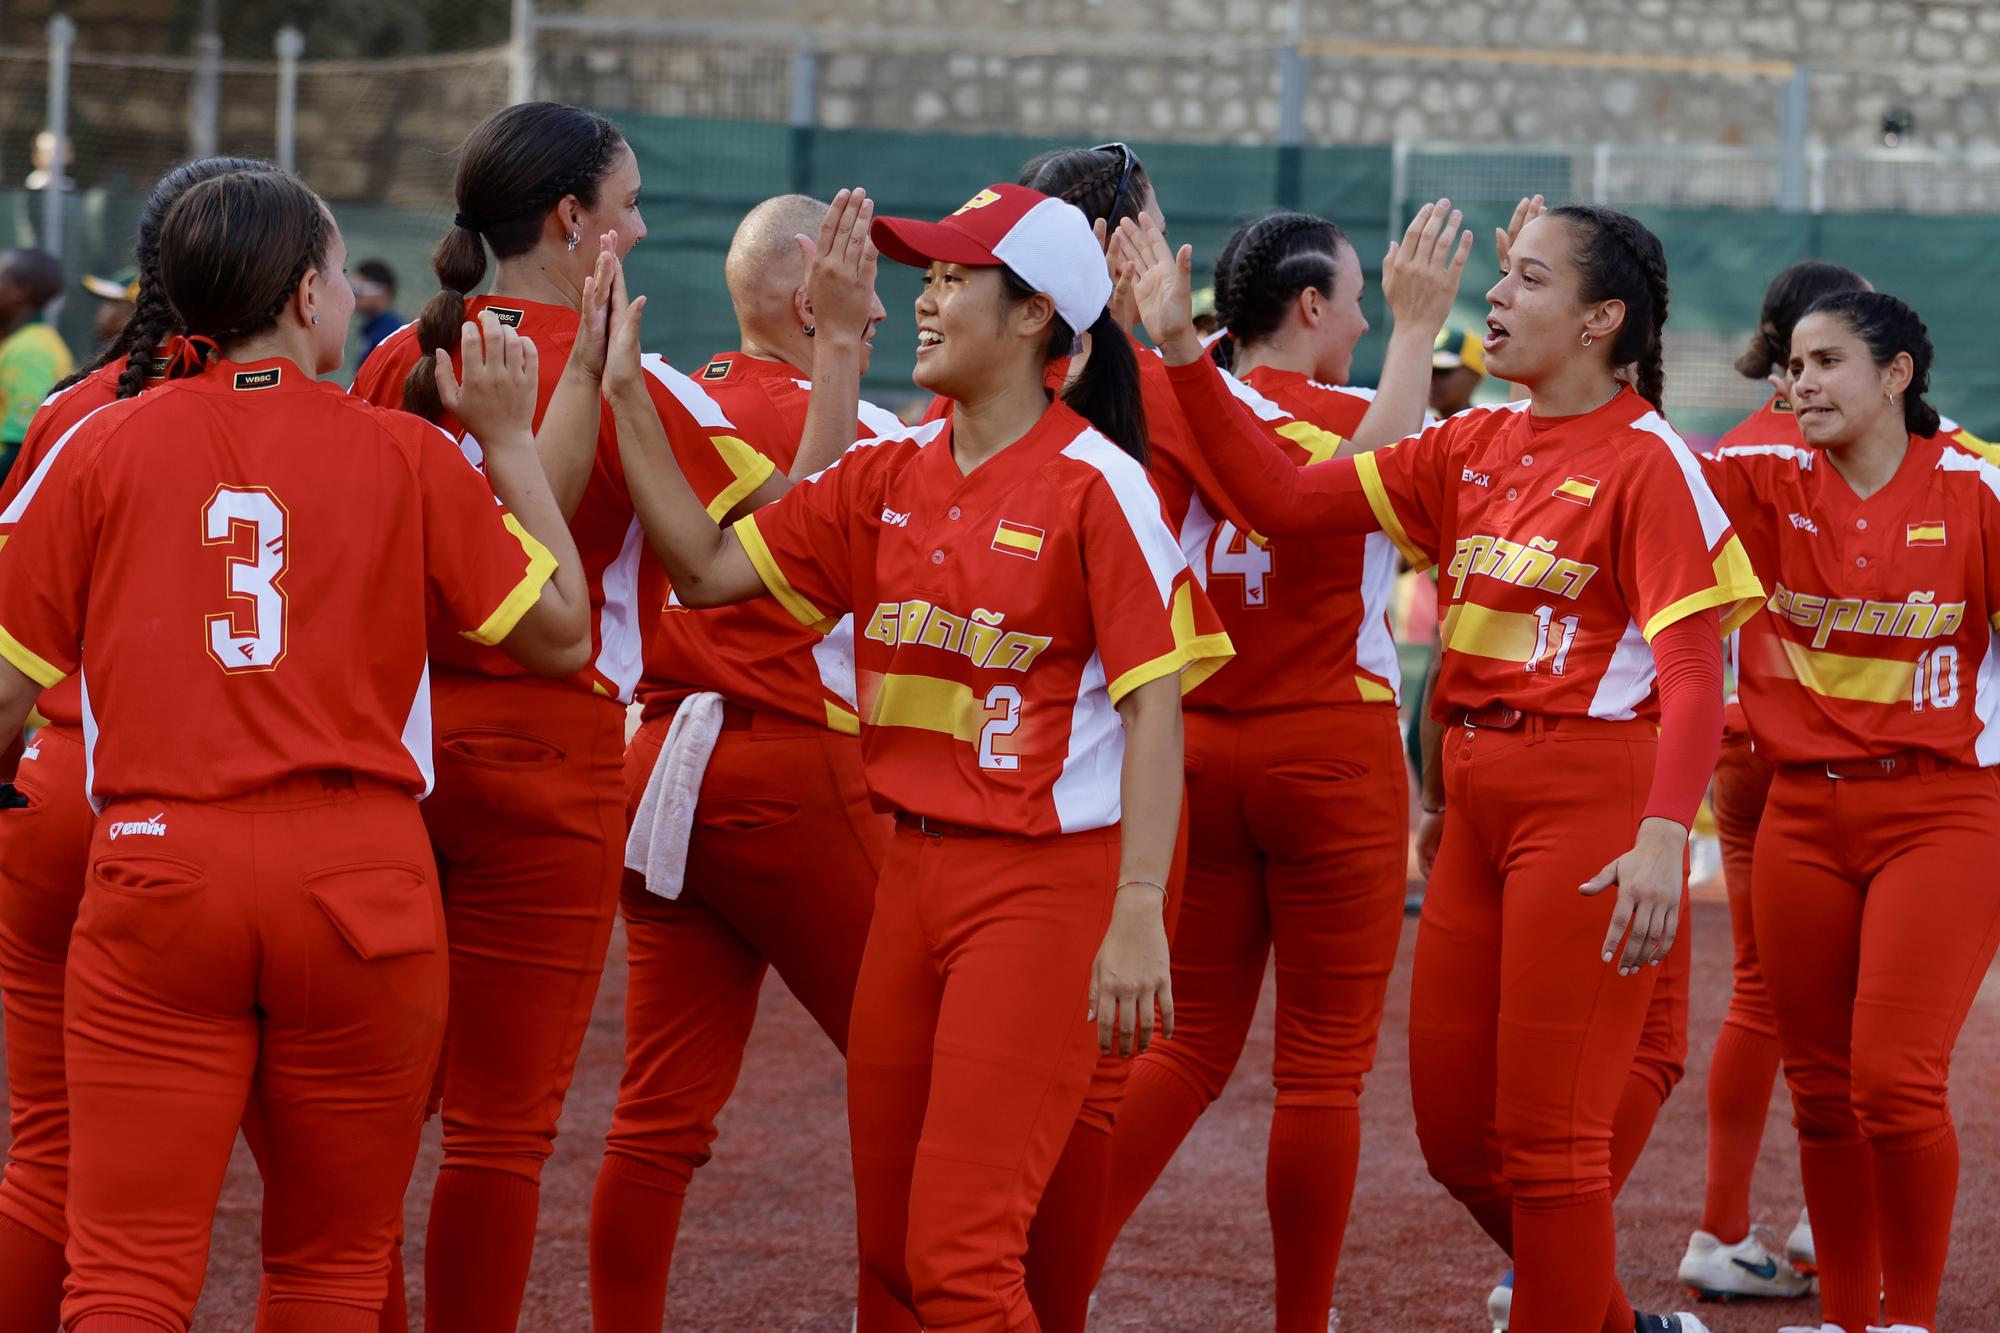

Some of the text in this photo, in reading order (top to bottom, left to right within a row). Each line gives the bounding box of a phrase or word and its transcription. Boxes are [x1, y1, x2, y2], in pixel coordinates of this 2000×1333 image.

[245, 374, 272, 384] WBSC
[202, 483, 288, 675] 3
[1210, 519, 1274, 608] 4
[1524, 603, 1582, 677] 11
[1911, 645, 1961, 714] 10
[977, 682, 1024, 772] 2
